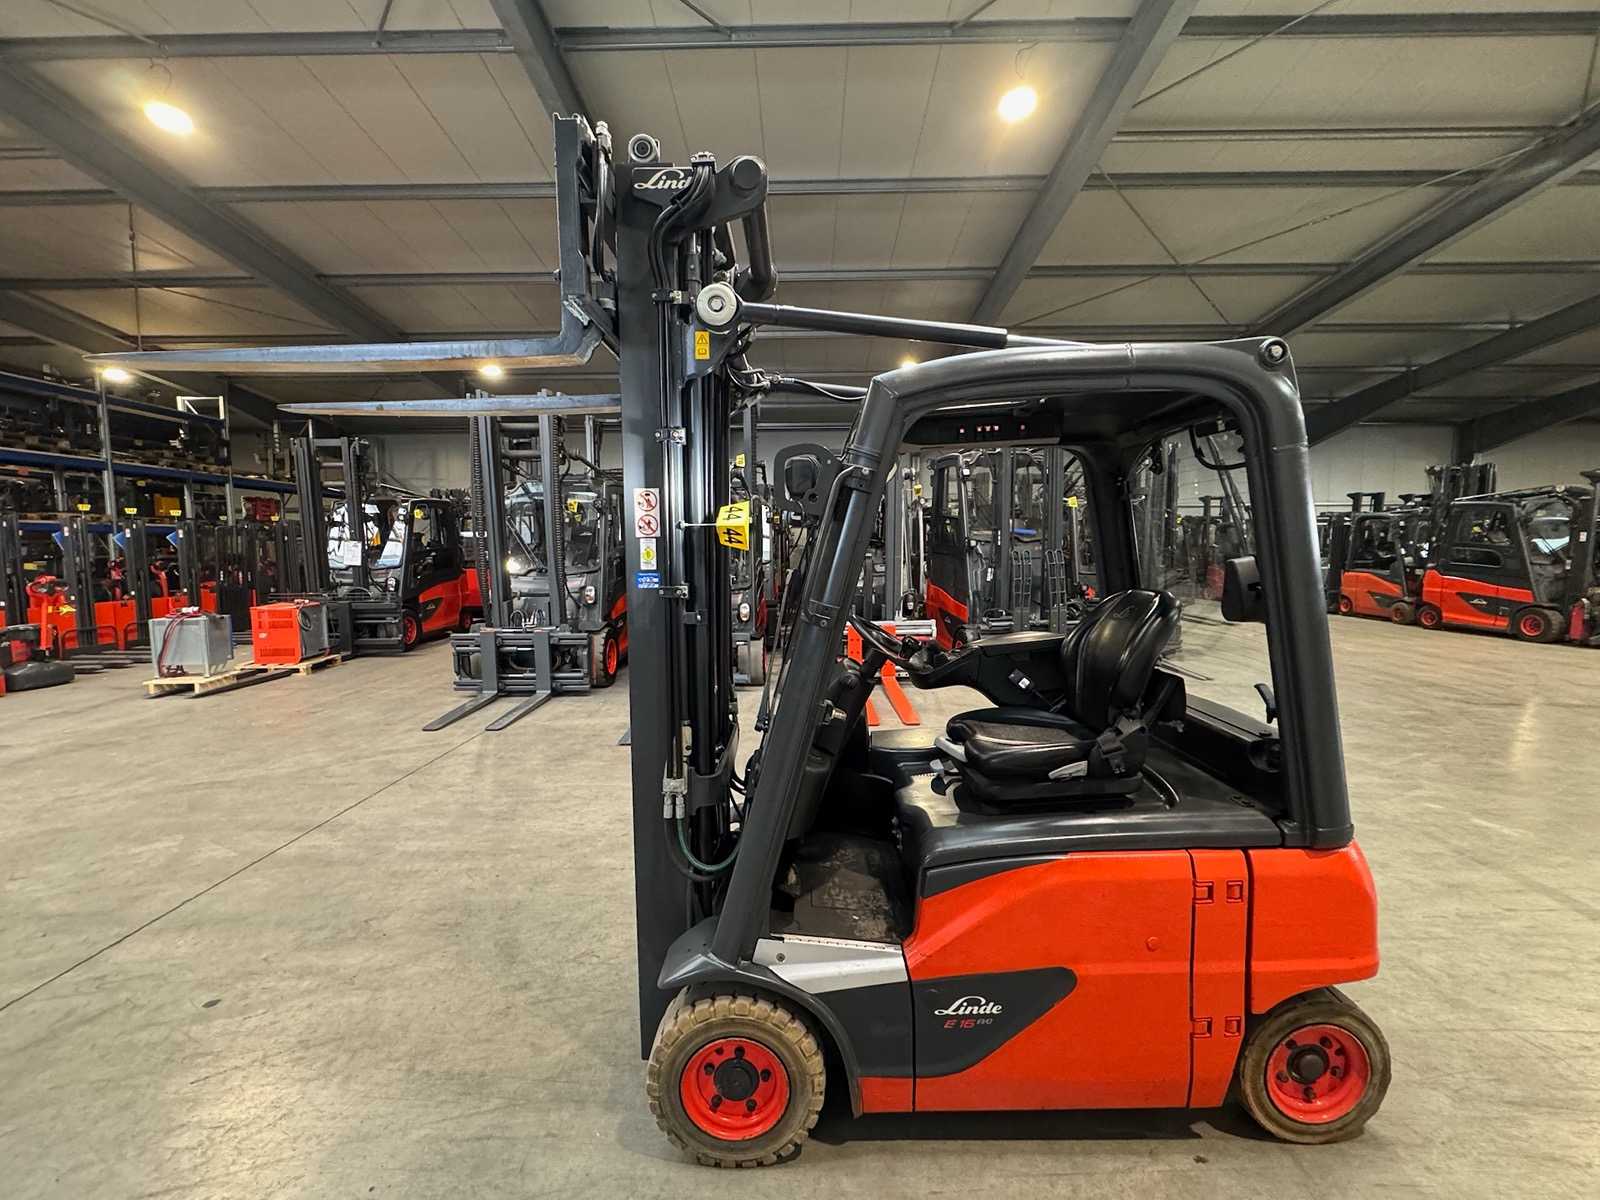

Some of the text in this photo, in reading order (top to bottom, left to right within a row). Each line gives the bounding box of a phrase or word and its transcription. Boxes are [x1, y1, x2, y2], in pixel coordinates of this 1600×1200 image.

[634, 169, 692, 189] Lind
[723, 528, 744, 544] 44
[934, 995, 1003, 1016] Linde
